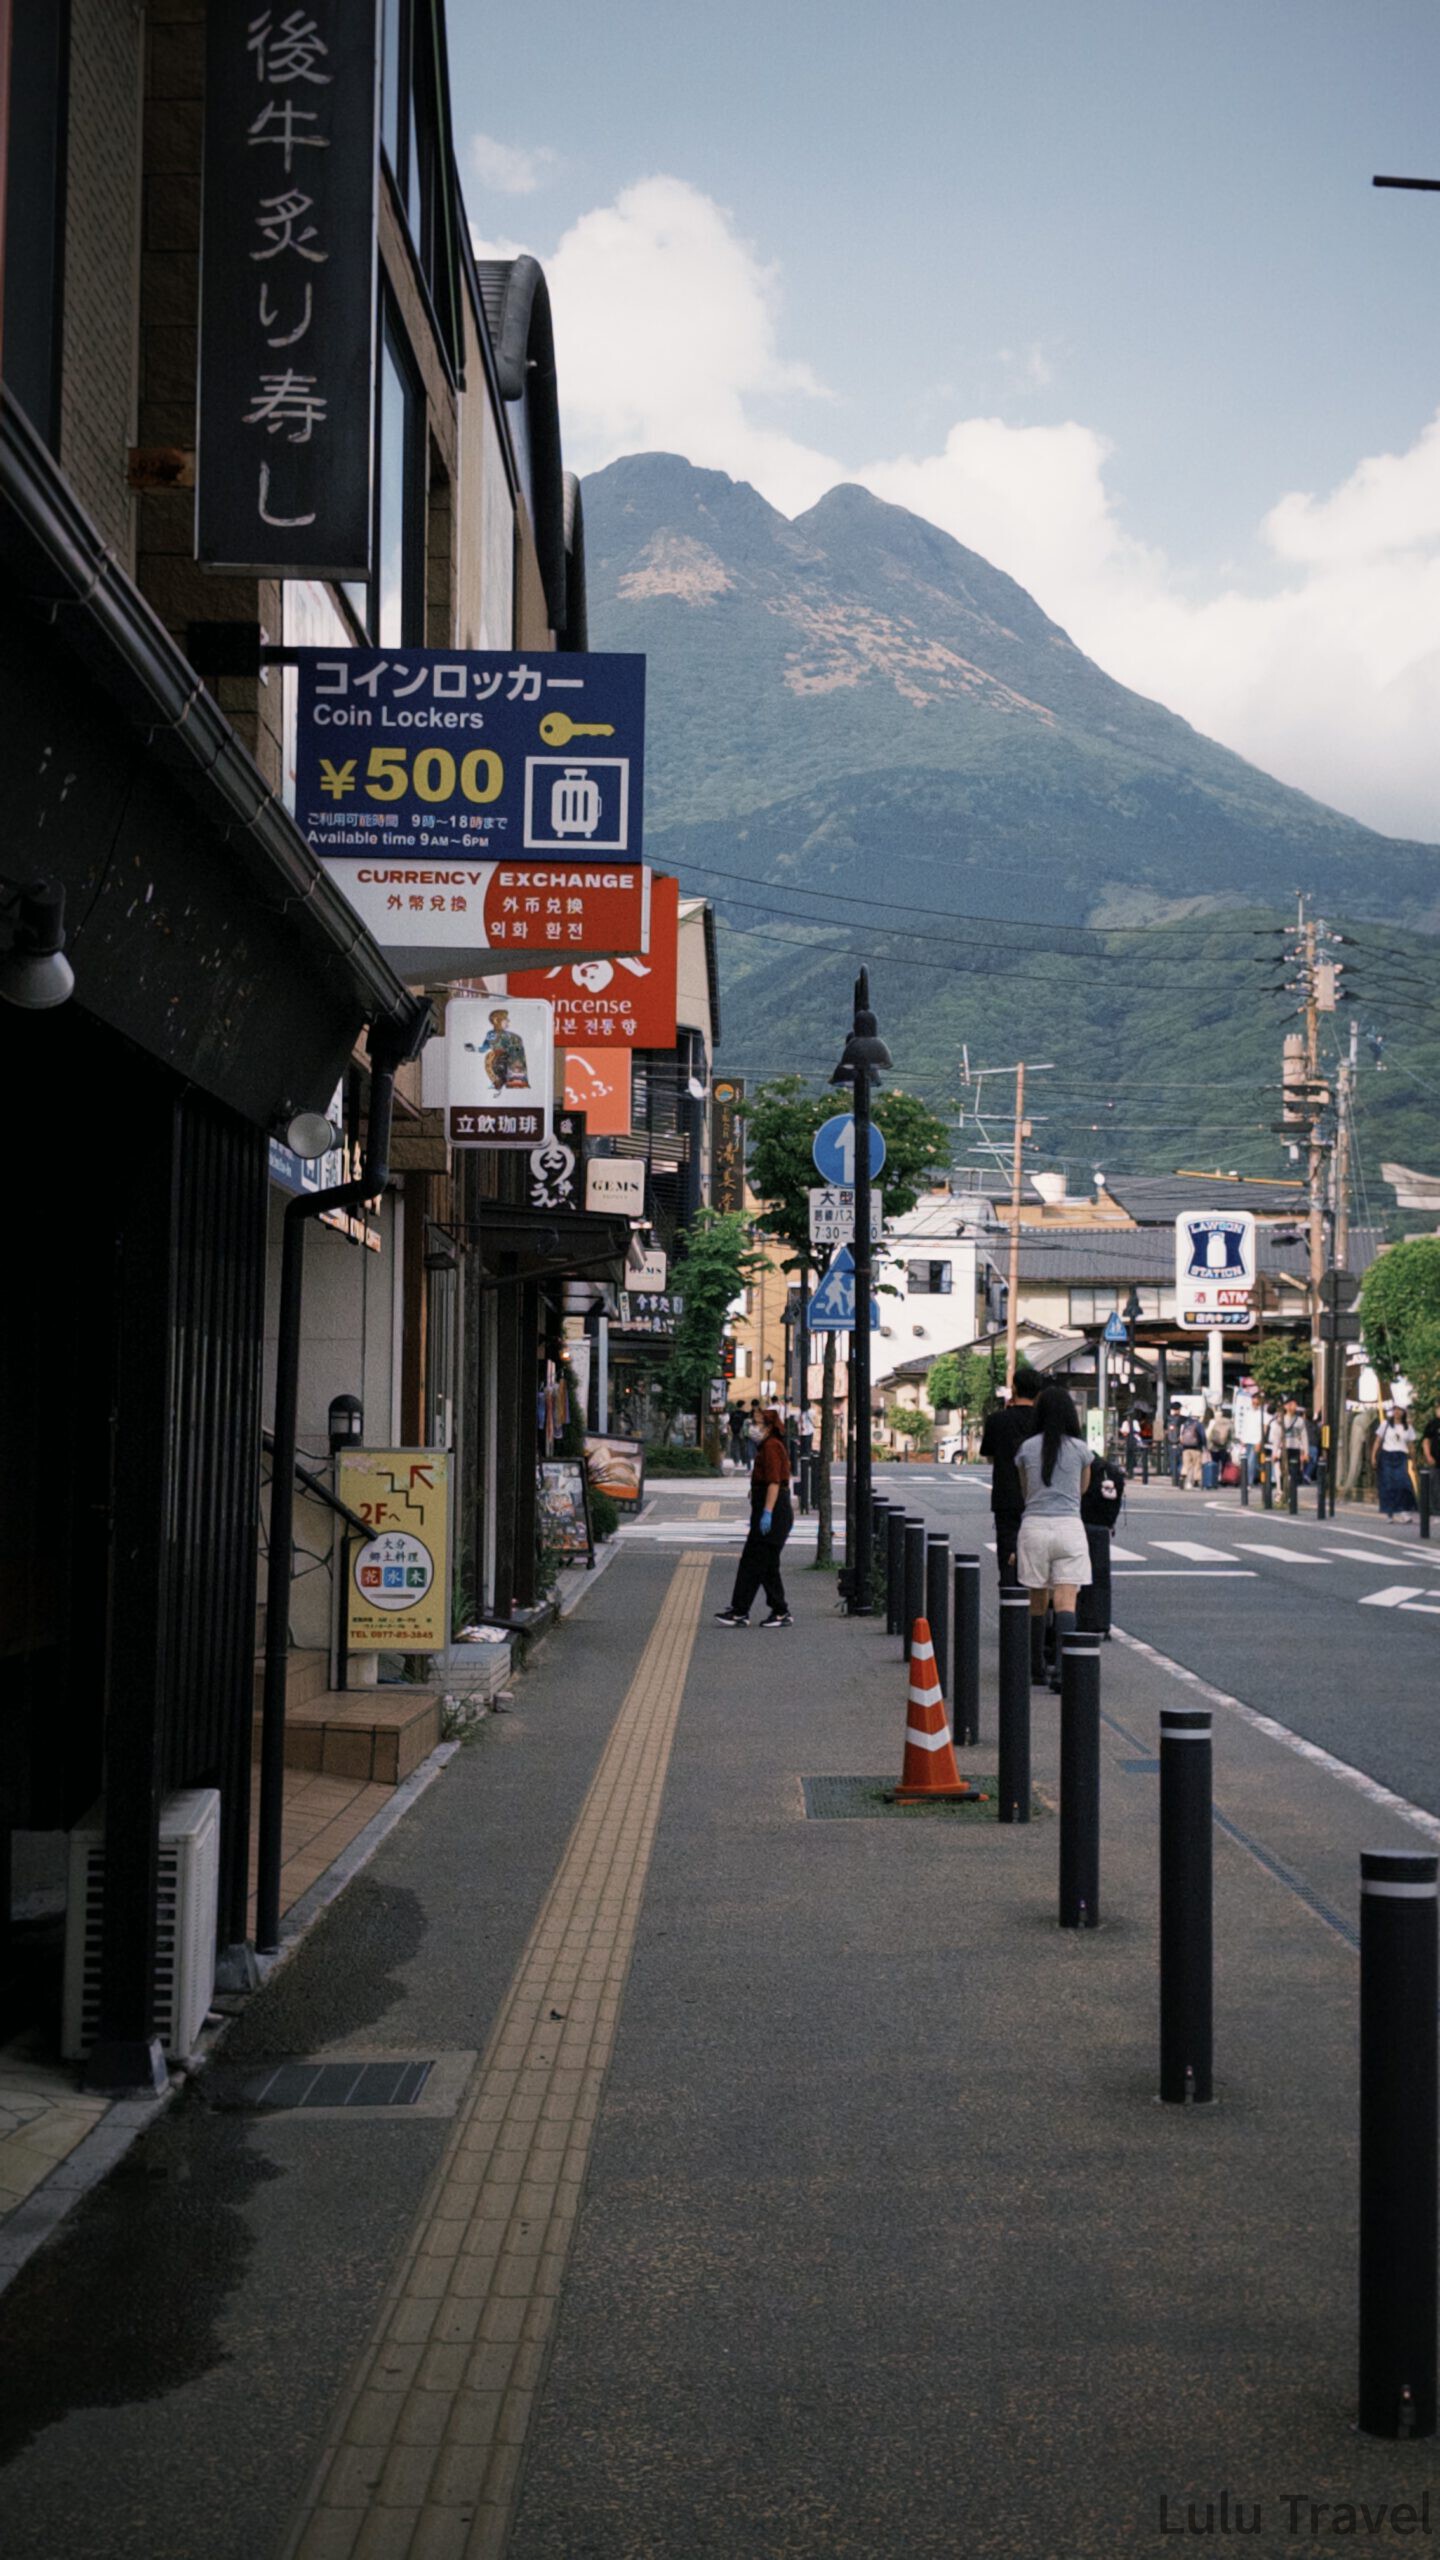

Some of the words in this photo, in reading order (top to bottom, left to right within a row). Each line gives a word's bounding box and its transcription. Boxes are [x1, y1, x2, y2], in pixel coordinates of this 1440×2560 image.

[242, 10, 334, 528] 後牛炙り寿し
[315, 660, 584, 702] コインロッカー
[313, 704, 372, 727] Coin
[381, 706, 484, 730] Lockers
[319, 746, 504, 804] ¥500
[307, 812, 399, 829] ご利用可能時間
[307, 830, 378, 845] Available
[383, 832, 416, 846] time
[357, 869, 482, 886] CURRENCY
[499, 871, 635, 890] EXCHANGE
[552, 995, 632, 1014] incense
[457, 1114, 538, 1135] 立飲珈琲
[592, 1180, 640, 1192] GEMS
[1190, 1221, 1243, 1234] LAWSON
[1191, 1265, 1243, 1278] STATION
[1219, 1292, 1248, 1303] ATM
